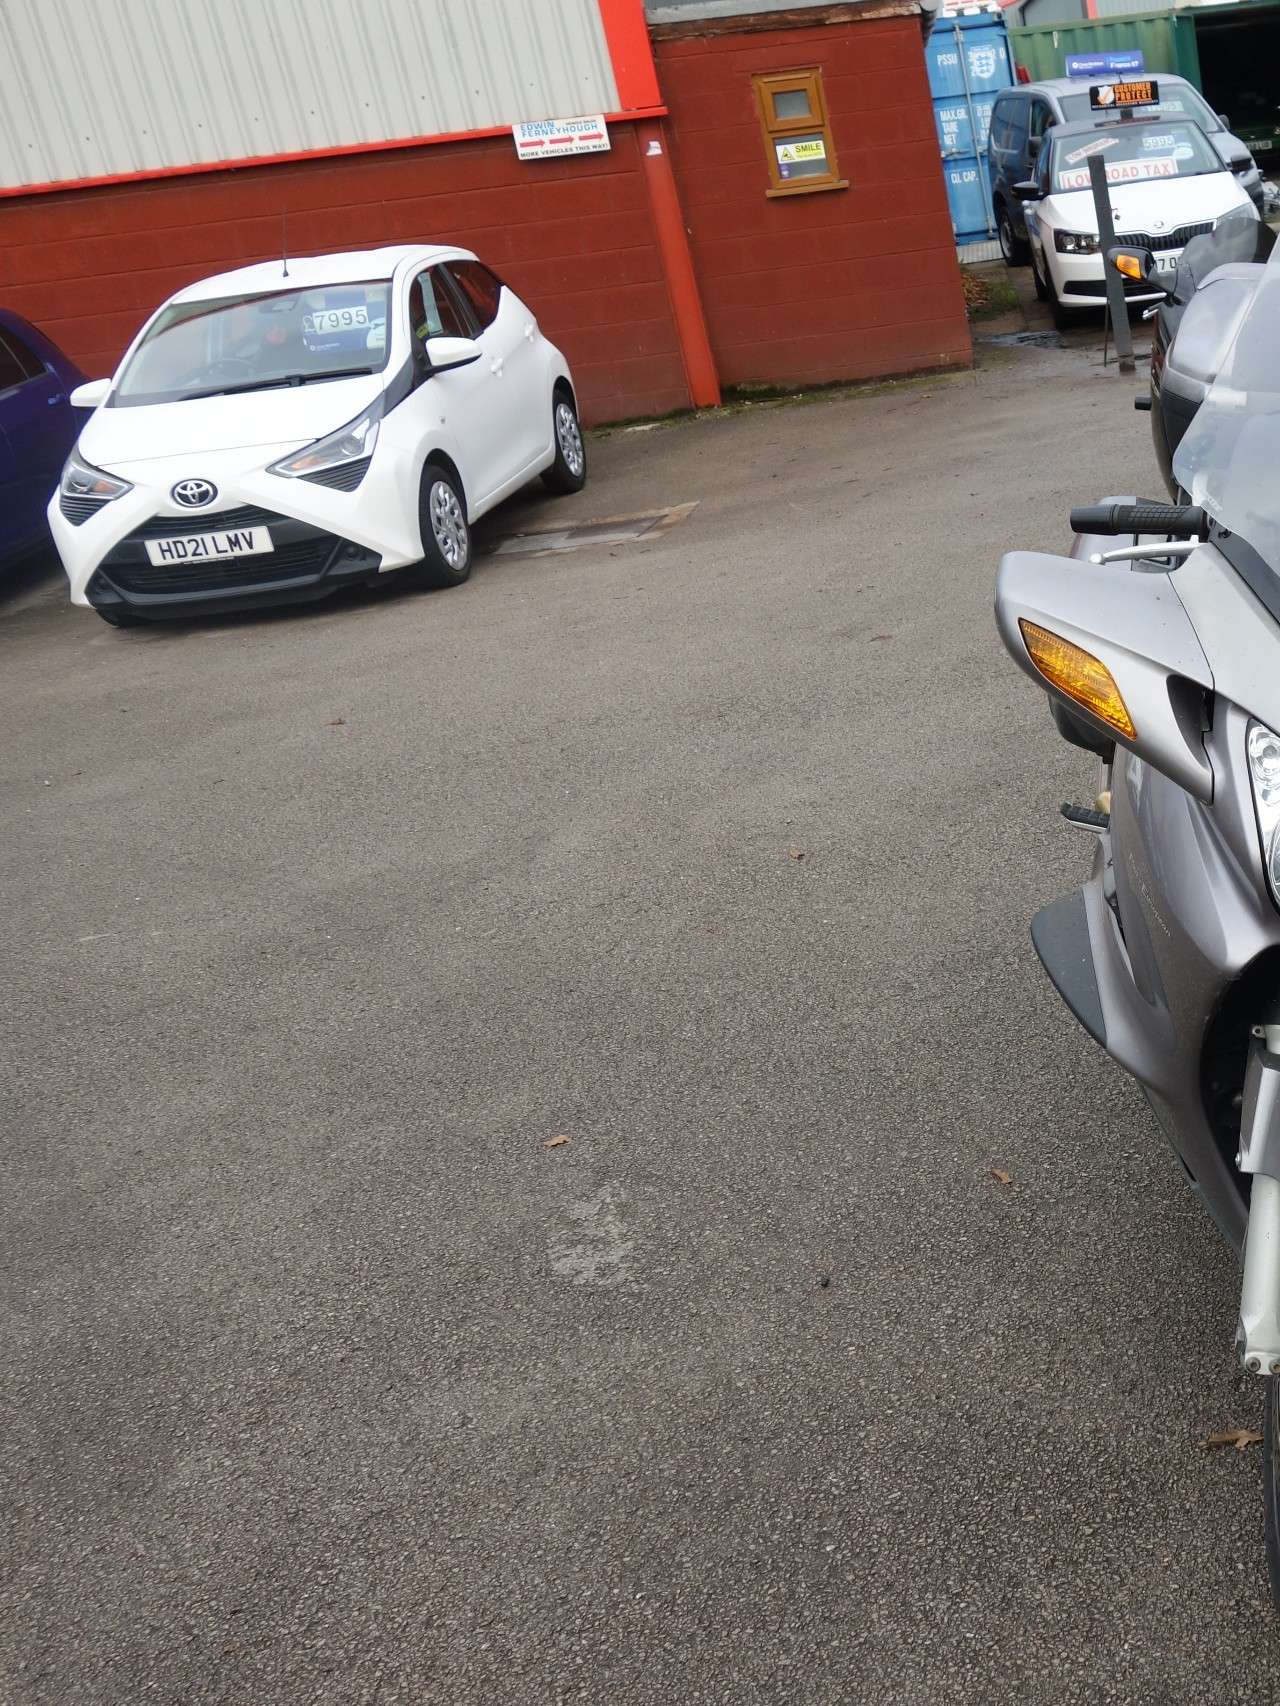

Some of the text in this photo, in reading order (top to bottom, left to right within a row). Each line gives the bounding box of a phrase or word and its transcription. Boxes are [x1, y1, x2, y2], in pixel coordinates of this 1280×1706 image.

[936, 53, 958, 65] PSSU
[1114, 82, 1151, 92] CUSTOMER
[1115, 90, 1152, 101] PROTECT
[520, 121, 555, 131] EDWIN
[521, 124, 598, 138] FERNEYHOUGH
[944, 133, 957, 145] NET
[541, 148, 574, 156] VEHICLES
[795, 142, 821, 153] SMILE
[1144, 163, 1170, 177] TAX
[963, 171, 979, 183] CAP.
[158, 531, 254, 560] HD21 LMV
